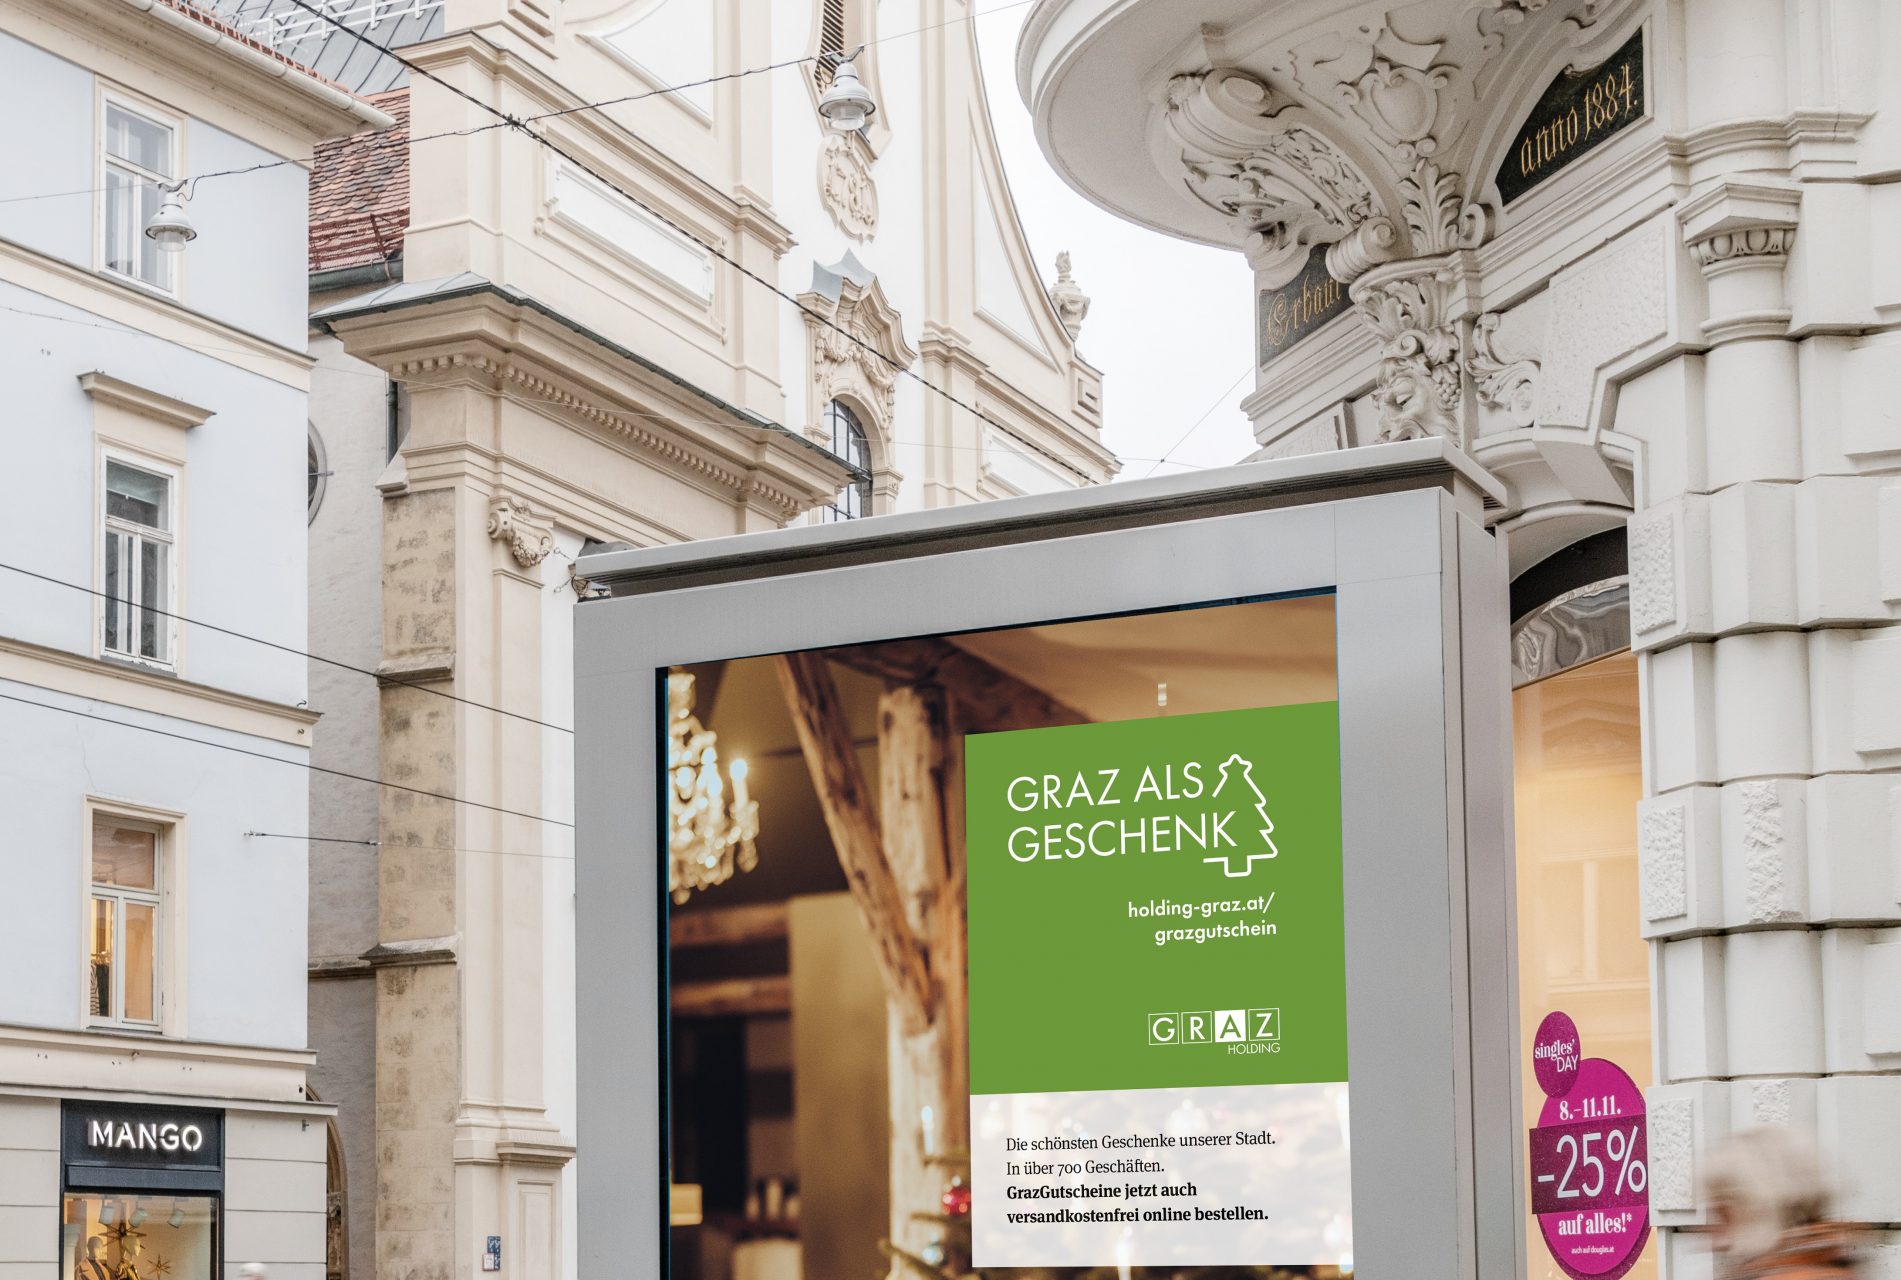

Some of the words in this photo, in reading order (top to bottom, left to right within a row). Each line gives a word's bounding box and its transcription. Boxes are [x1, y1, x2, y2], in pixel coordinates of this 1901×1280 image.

[1521, 106, 1578, 177] anno
[1584, 63, 1638, 141] 1884.
[1007, 768, 1121, 812] GRAZ
[1133, 761, 1204, 803] ALS
[1007, 810, 1238, 863] GESCHENK
[1128, 891, 1276, 919] holding-graz.at/
[1154, 919, 1277, 946] grazgutschein
[1151, 1011, 1274, 1042] GRAZ
[1227, 1042, 1281, 1055] HOLDING
[1556, 1054, 1579, 1073] DAY
[88, 1119, 203, 1152] MANGO
[1006, 1137, 1028, 1151] Die
[1031, 1136, 1098, 1150] schönsten
[1101, 1134, 1176, 1149] Geschenke
[1179, 1135, 1232, 1147] unserer
[1235, 1130, 1276, 1145] Stadt.
[1006, 1161, 1021, 1175] In
[1023, 1161, 1054, 1175] über
[1057, 1163, 1082, 1177] 700
[1085, 1158, 1165, 1174] Geschäften.
[1537, 1124, 1647, 1199] -25%
[1006, 1183, 1122, 1199] GrazGutscheine
[1124, 1183, 1158, 1200] jetzt
[1161, 1182, 1197, 1197] auch
[1006, 1207, 1140, 1223] versandkostenfrei
[1143, 1207, 1192, 1221] online
[1194, 1206, 1269, 1221] bestellen.
[1558, 1212, 1584, 1236] auf
